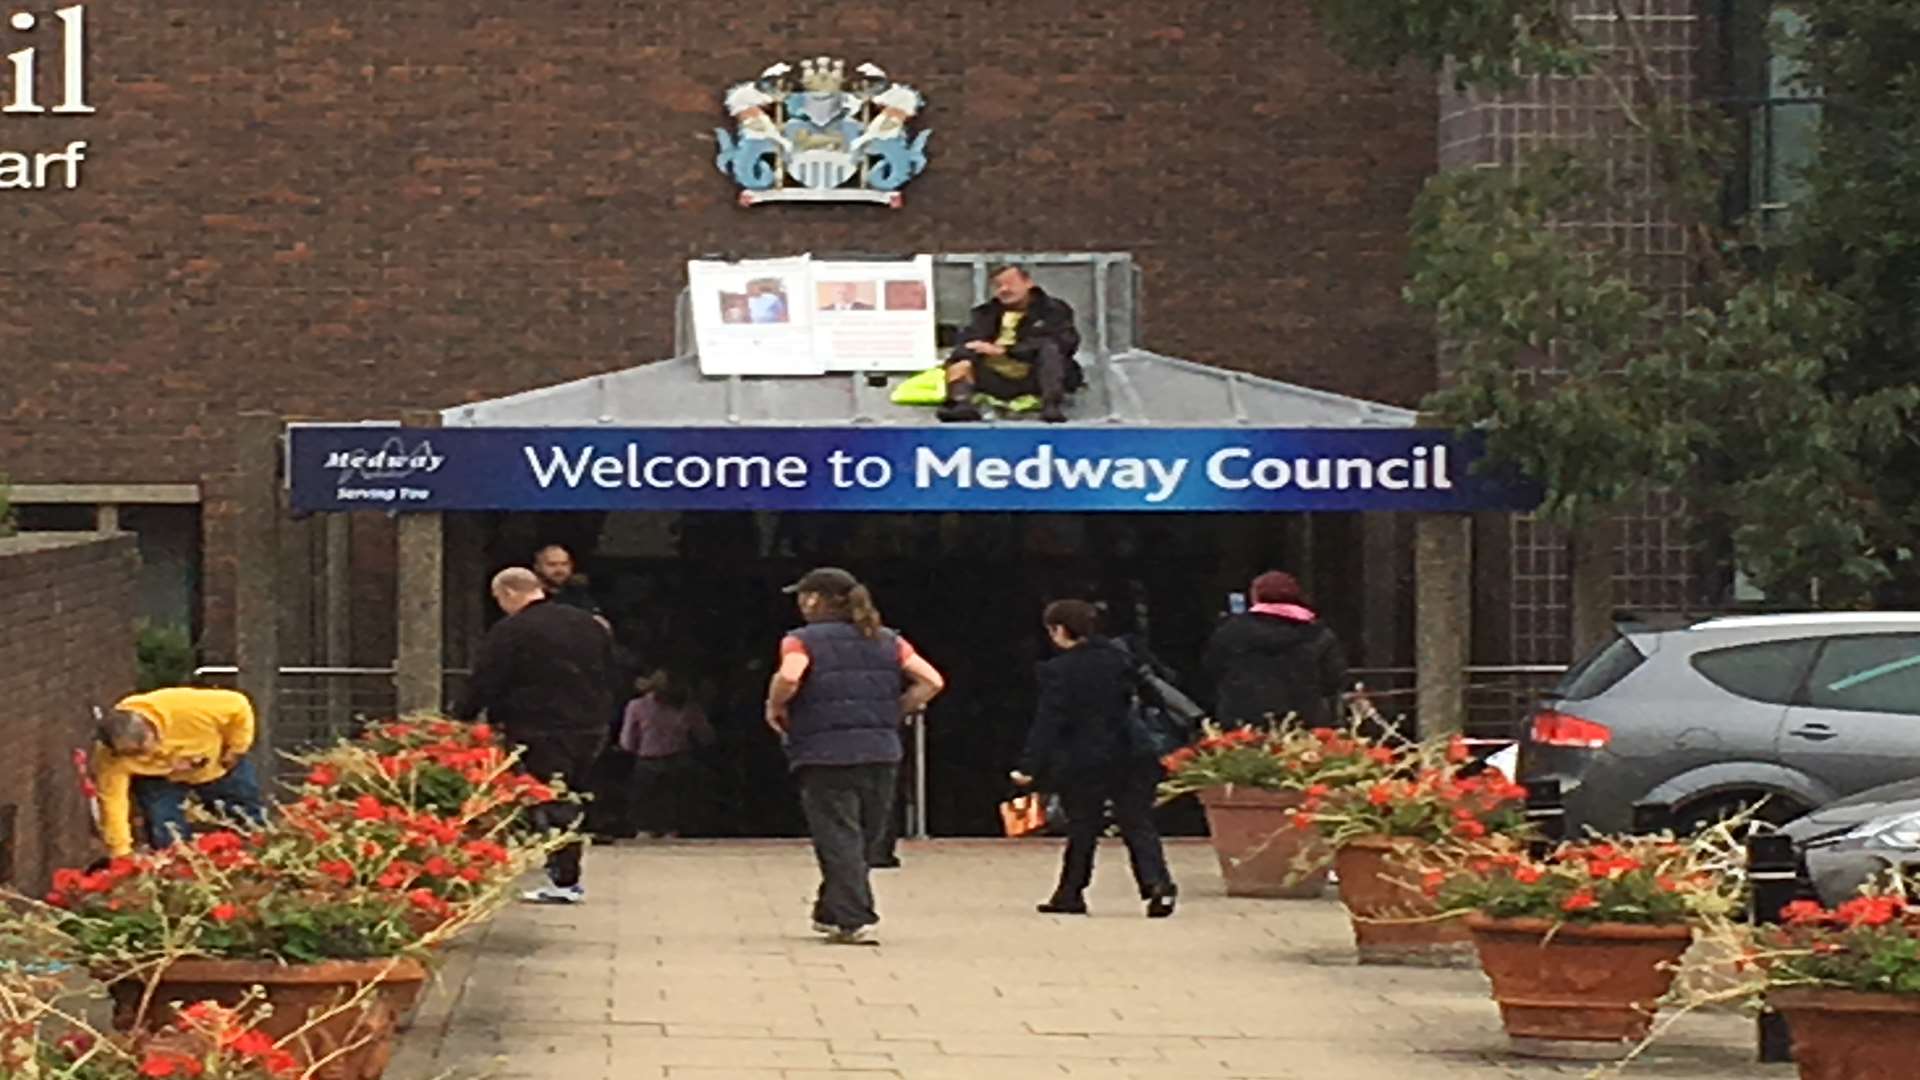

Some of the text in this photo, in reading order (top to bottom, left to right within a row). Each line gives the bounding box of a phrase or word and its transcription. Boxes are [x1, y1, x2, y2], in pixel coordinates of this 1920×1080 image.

[323, 450, 445, 472] Medway
[524, 443, 1452, 502] Welcome to Medway Council
